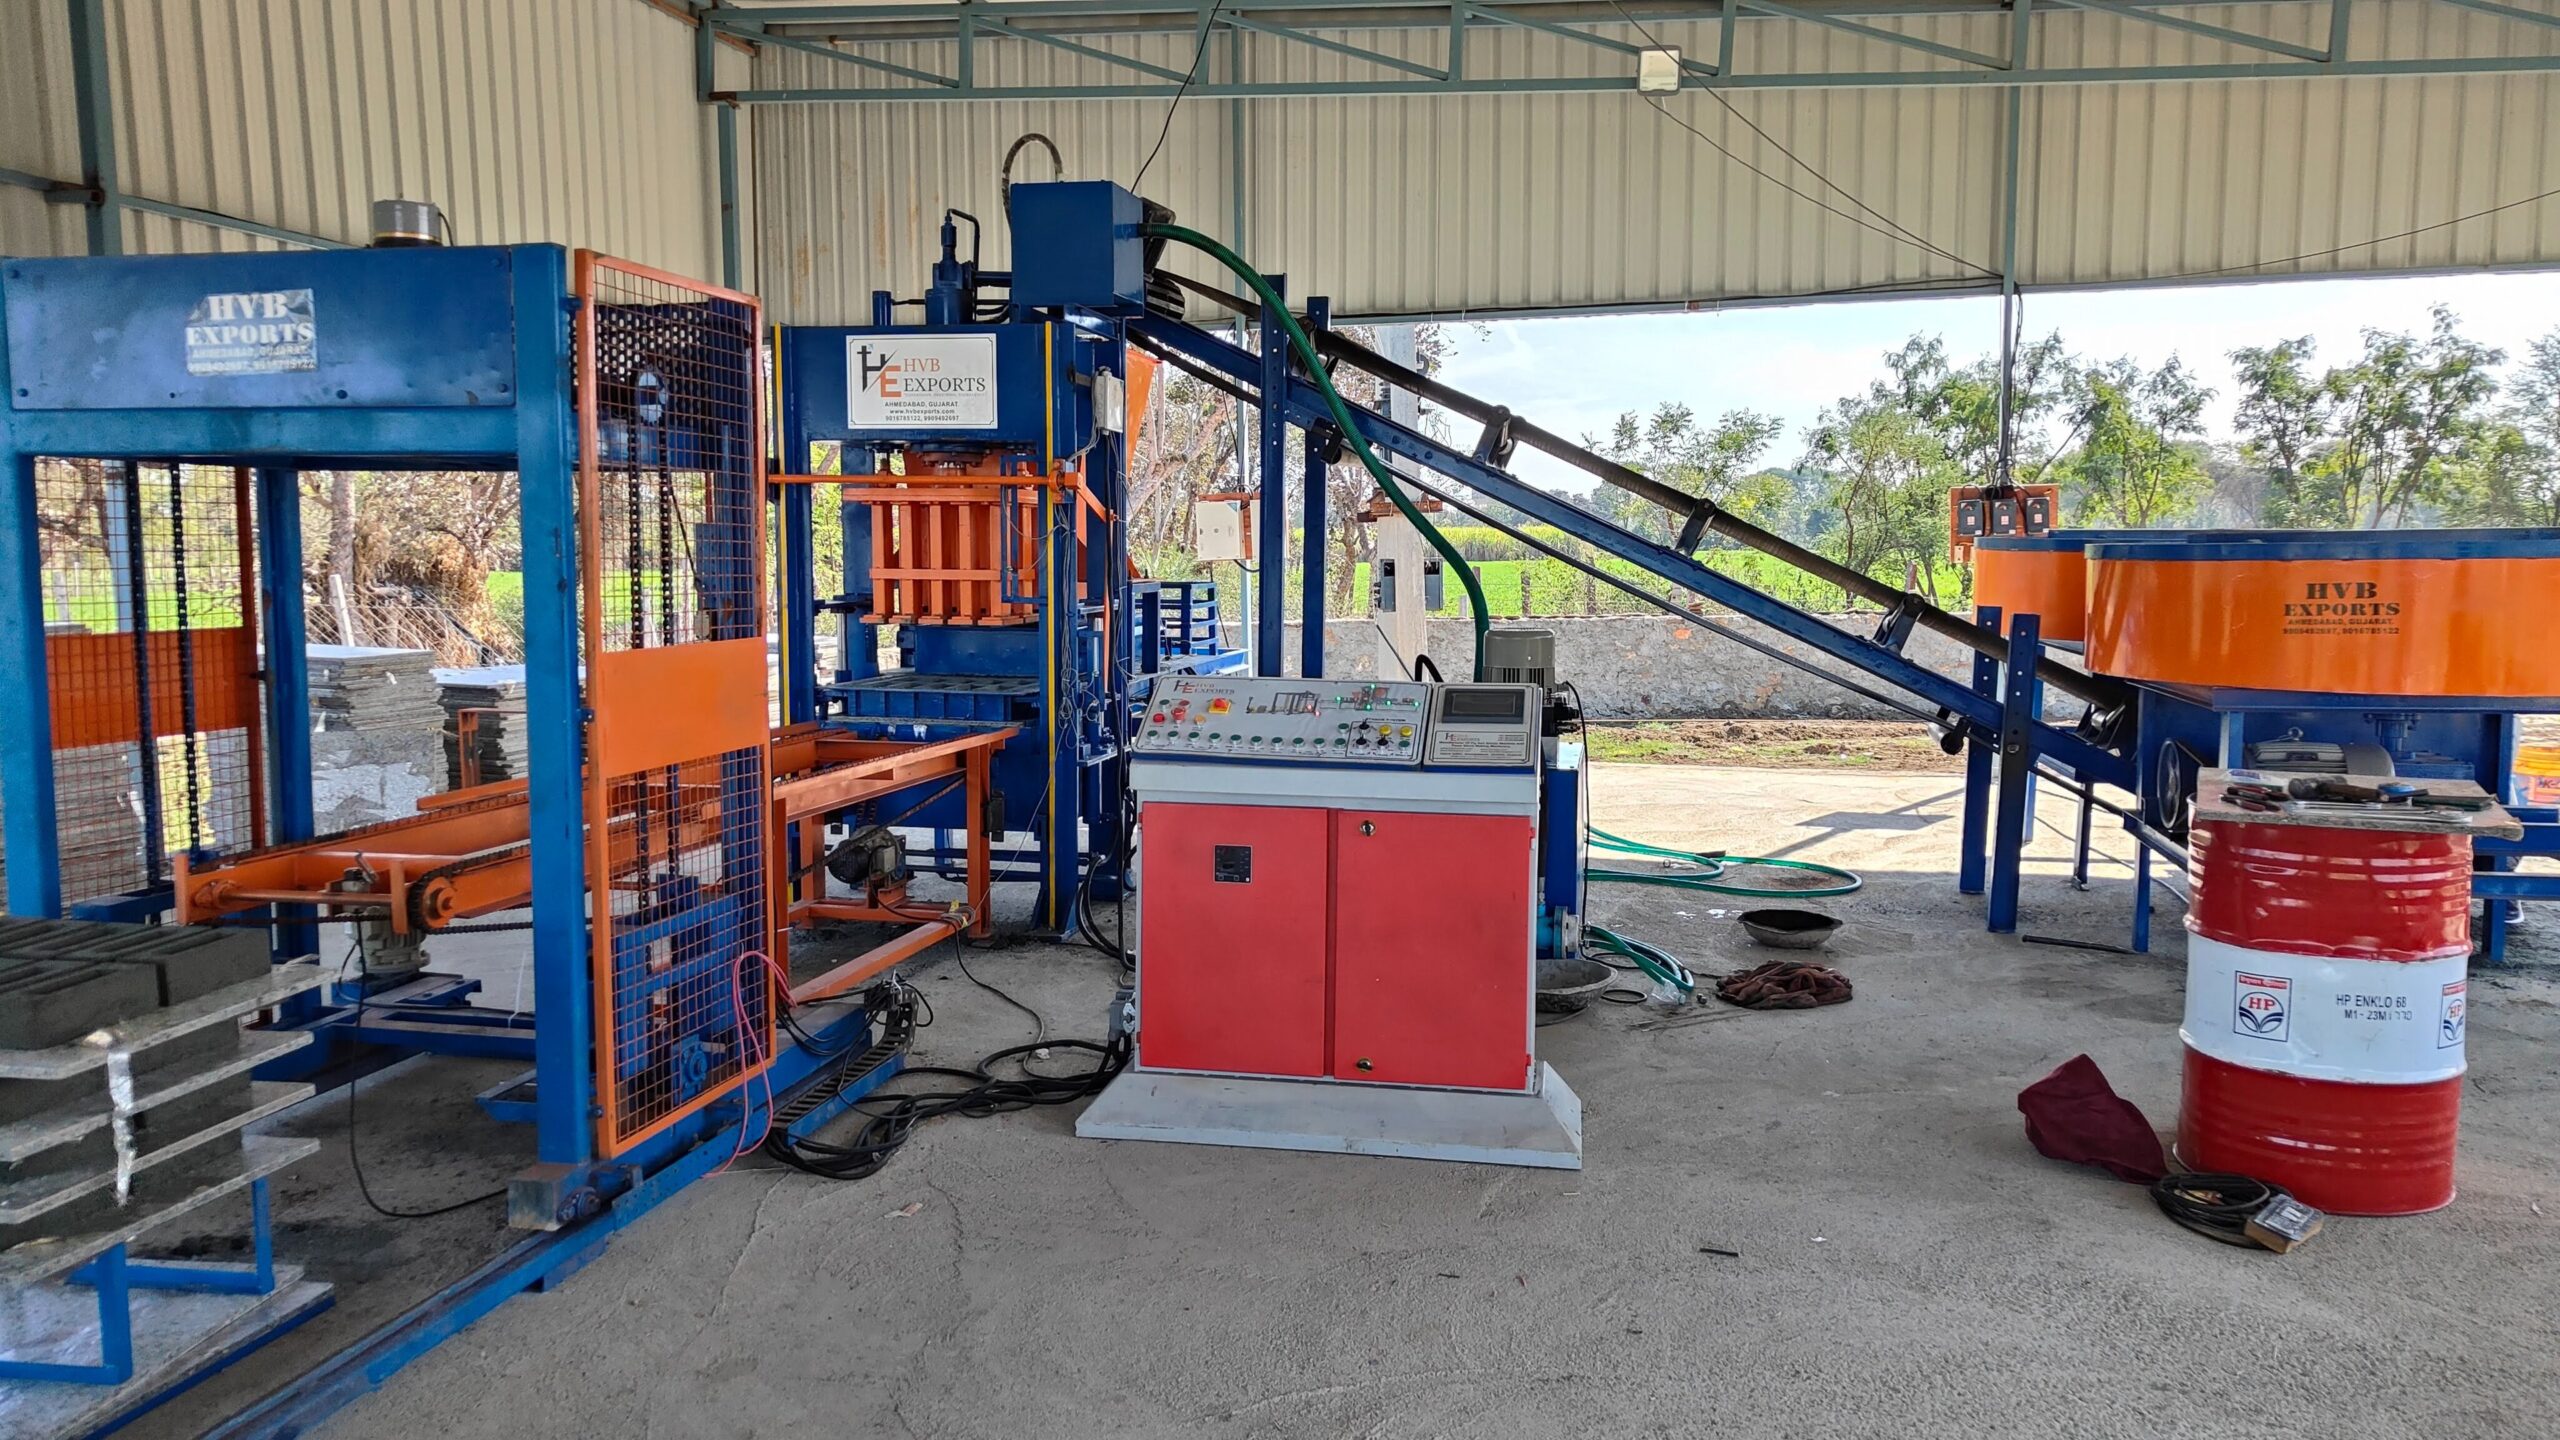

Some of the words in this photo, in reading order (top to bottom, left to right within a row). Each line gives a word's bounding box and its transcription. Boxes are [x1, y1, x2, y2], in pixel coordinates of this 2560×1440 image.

[207, 293, 288, 321] HVB
[186, 323, 316, 346] EXPORTS
[903, 358, 941, 372] HVB
[903, 377, 986, 392] EXPORTS
[2305, 582, 2378, 600] HVB
[2283, 602, 2401, 617] EXPORTS
[2248, 996, 2276, 1011] HP
[2335, 994, 2351, 1006] HP
[2355, 994, 2393, 1008] ENKLO
